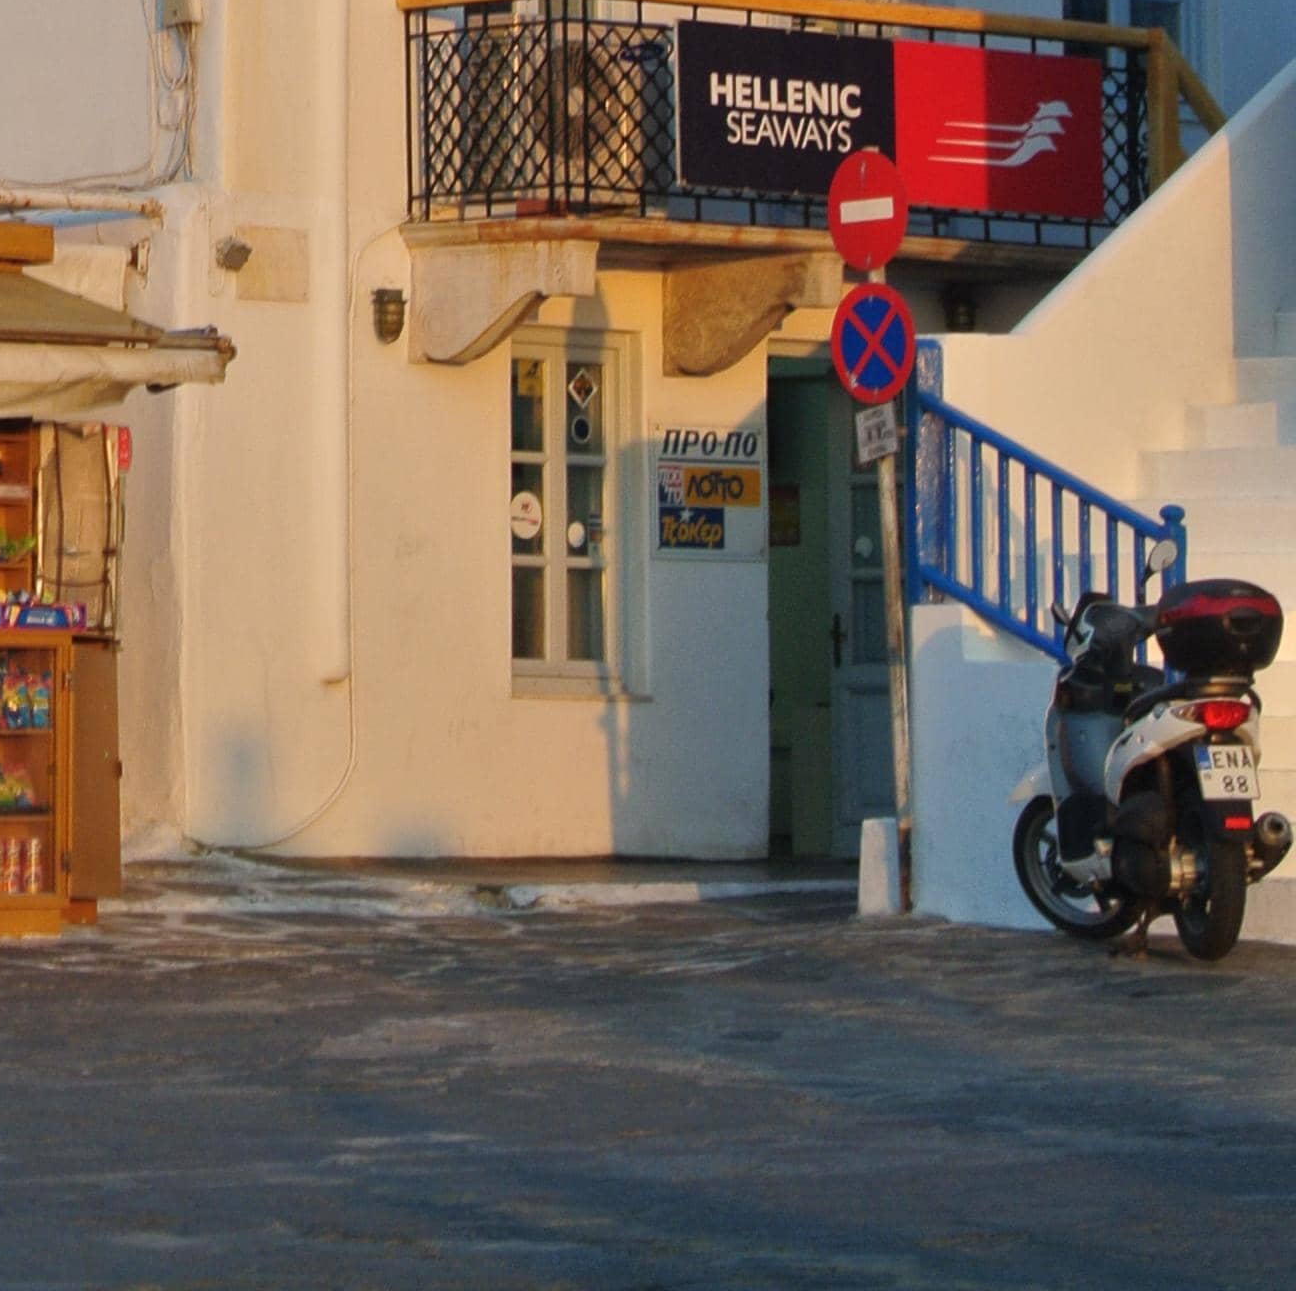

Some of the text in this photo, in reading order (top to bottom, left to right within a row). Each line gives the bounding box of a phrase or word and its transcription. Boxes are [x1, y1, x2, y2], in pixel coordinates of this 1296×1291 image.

[710, 72, 862, 118] HELLENIC
[727, 110, 852, 153] SEAWAYS
[662, 429, 758, 457] ΠΡΟ-ΠΟ
